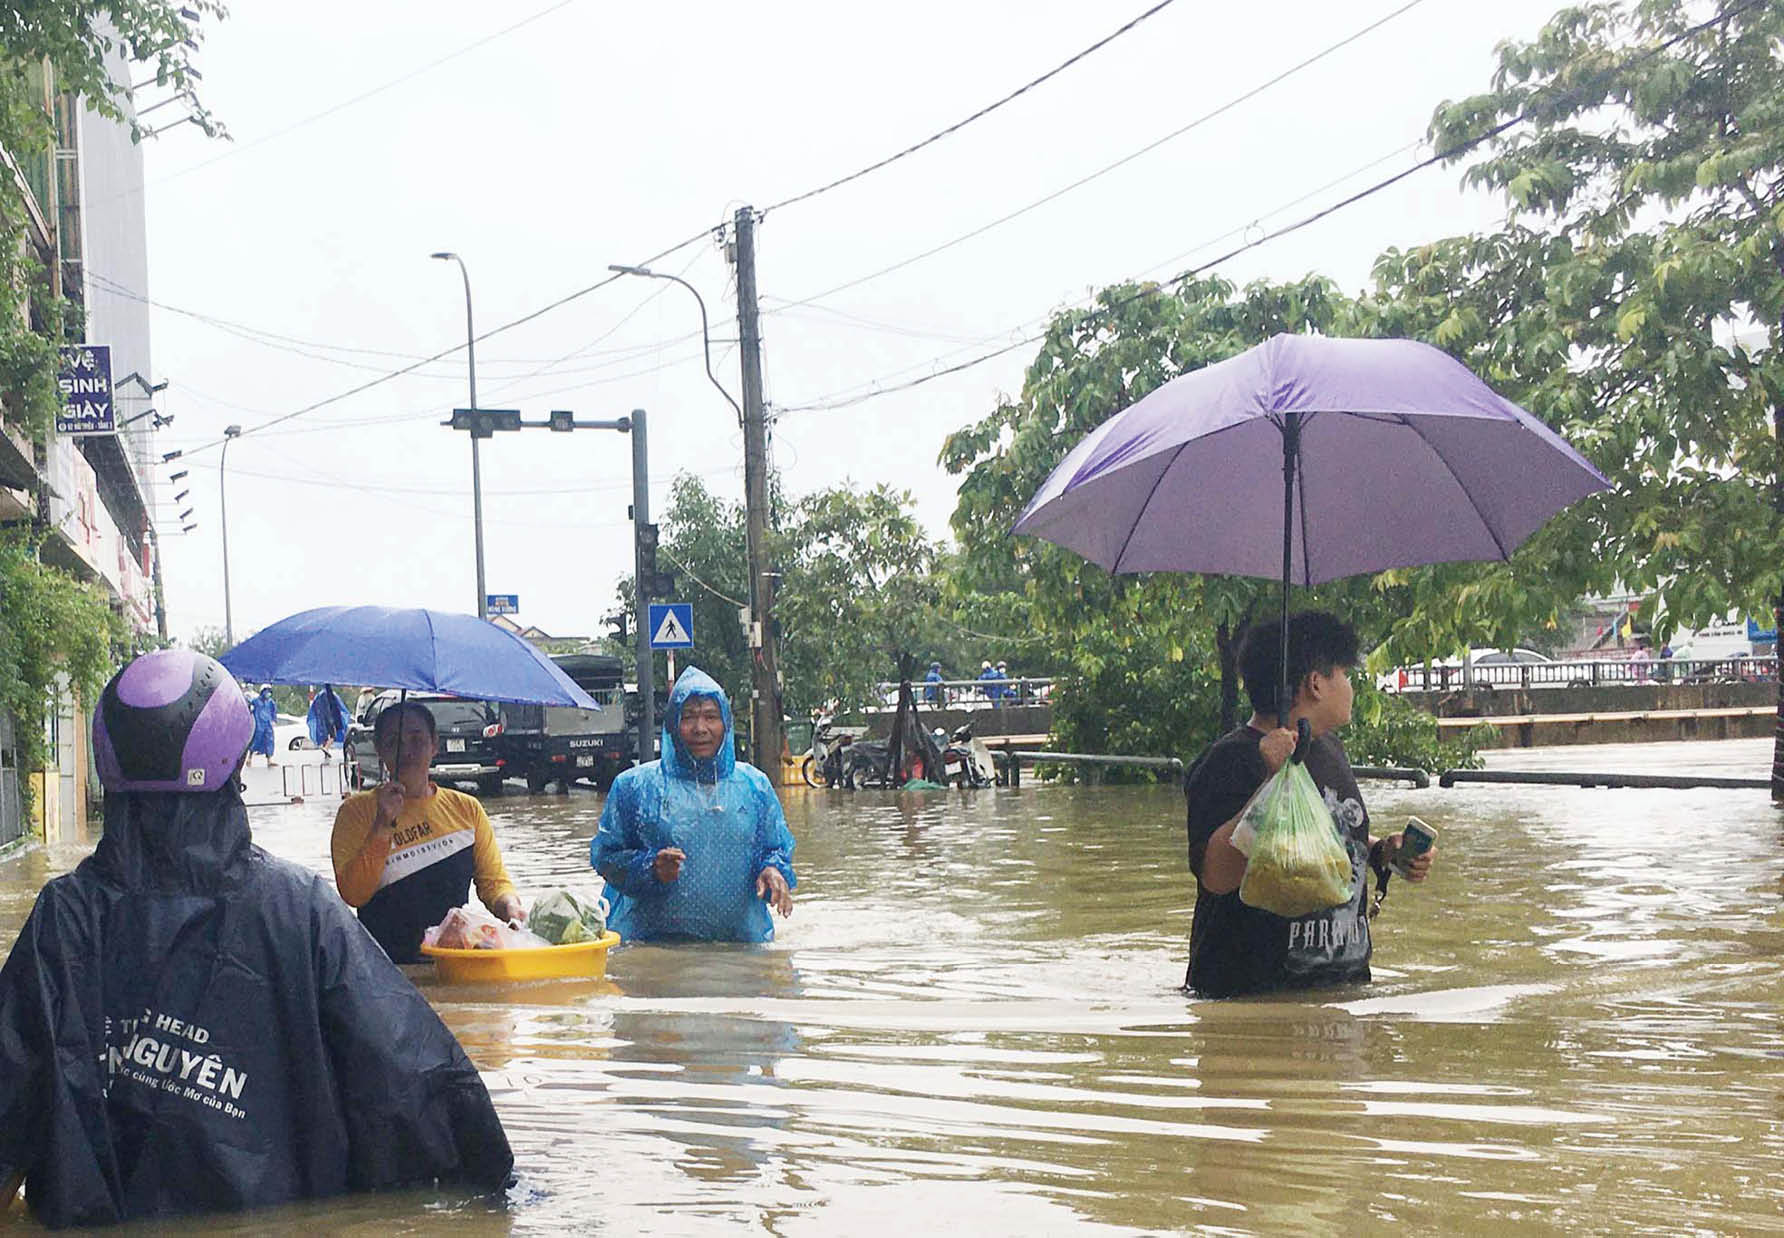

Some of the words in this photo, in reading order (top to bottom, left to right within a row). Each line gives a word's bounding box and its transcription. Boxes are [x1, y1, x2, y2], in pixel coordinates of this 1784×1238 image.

[59, 379, 107, 393] SINH
[63, 400, 108, 418] GIÀY
[569, 739, 604, 748] SUZUKI
[155, 1013, 210, 1044] HEAD
[224, 1101, 246, 1119] Bạn
